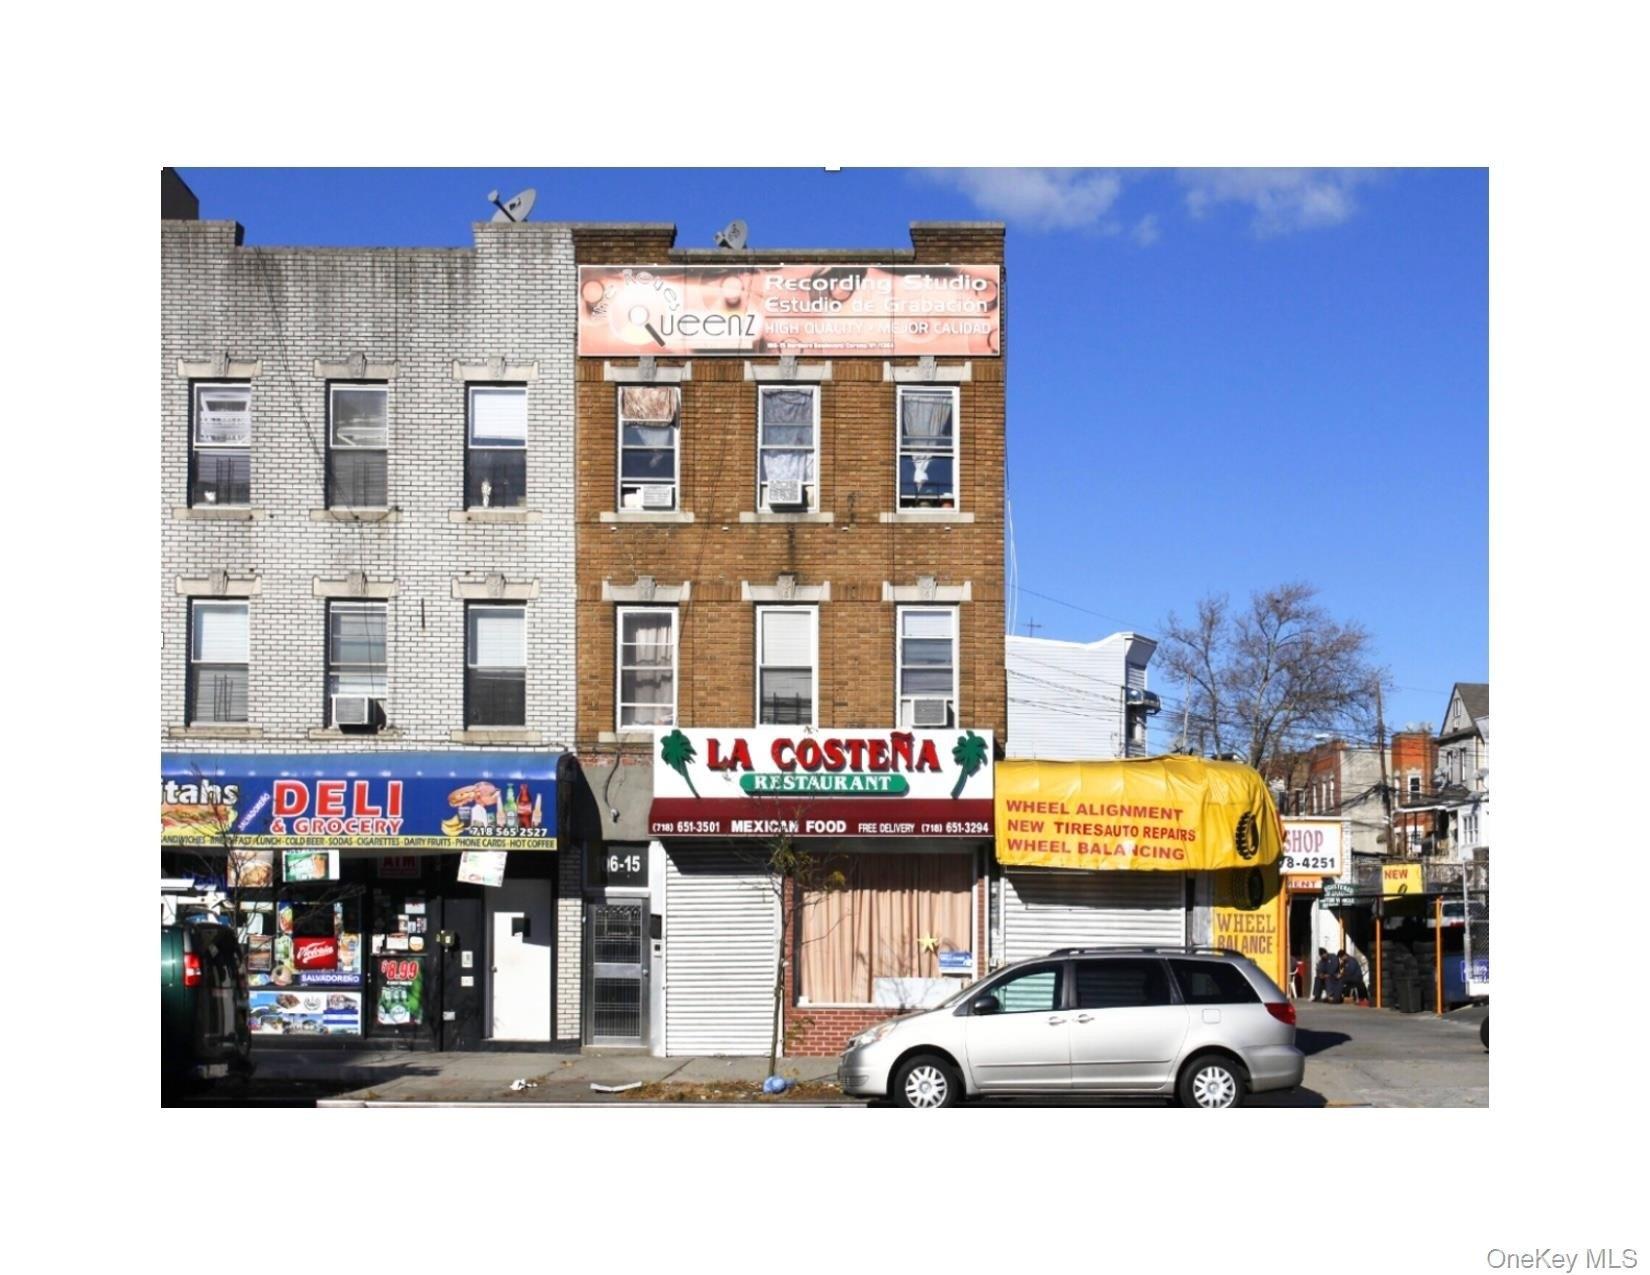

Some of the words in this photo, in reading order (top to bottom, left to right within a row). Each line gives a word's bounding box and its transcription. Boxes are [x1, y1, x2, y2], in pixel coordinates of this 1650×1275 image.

[764, 274, 892, 294] Recording
[903, 273, 988, 291] Studio
[764, 296, 842, 313] Estudio
[852, 297, 876, 313] de
[764, 321, 799, 335] HIGH
[804, 321, 863, 335] QUALITY
[880, 321, 929, 335] MEJOR
[934, 321, 991, 335] CALIDAD
[706, 738, 754, 772] LA
[770, 731, 943, 773] COSTEÑA
[754, 774, 892, 790] RESTAURANT
[272, 780, 404, 818] DELI
[1006, 800, 1070, 815] WHEEL
[1075, 803, 1183, 821] ALIGNMENT
[270, 817, 286, 835] &
[293, 817, 404, 836] GROCERY
[495, 827, 516, 837] 565
[519, 827, 548, 838] 2527
[652, 823, 674, 832] (718)
[676, 821, 720, 832] 651-3501
[731, 820, 799, 833] MEXICAN
[806, 820, 847, 833] FOOD
[858, 822, 877, 833] FREE
[879, 822, 915, 833] DELIVERY
[921, 823, 942, 833] (718)
[945, 822, 989, 833] 651-3294
[1007, 819, 1045, 833] NEW
[1142, 826, 1196, 842] REPAIRS
[161, 835, 203, 844] ANDWICHES
[285, 836, 305, 845] COLD
[328, 837, 353, 846] SODAS
[356, 837, 400, 846] CIGARETTES
[427, 837, 452, 846] FRUITS
[456, 838, 480, 847] PHONE
[481, 838, 506, 847] CARDS
[509, 838, 525, 848] HOT
[526, 838, 554, 848] COFFEE
[1007, 838, 1071, 853] WHEEL
[1077, 842, 1185, 860] BALANCING
[1284, 829, 1324, 854] SHOP
[606, 855, 641, 872] 6-15
[1384, 869, 1408, 880] NEW
[1216, 913, 1276, 934] WHEEL
[1217, 934, 1274, 954] BALANCE
